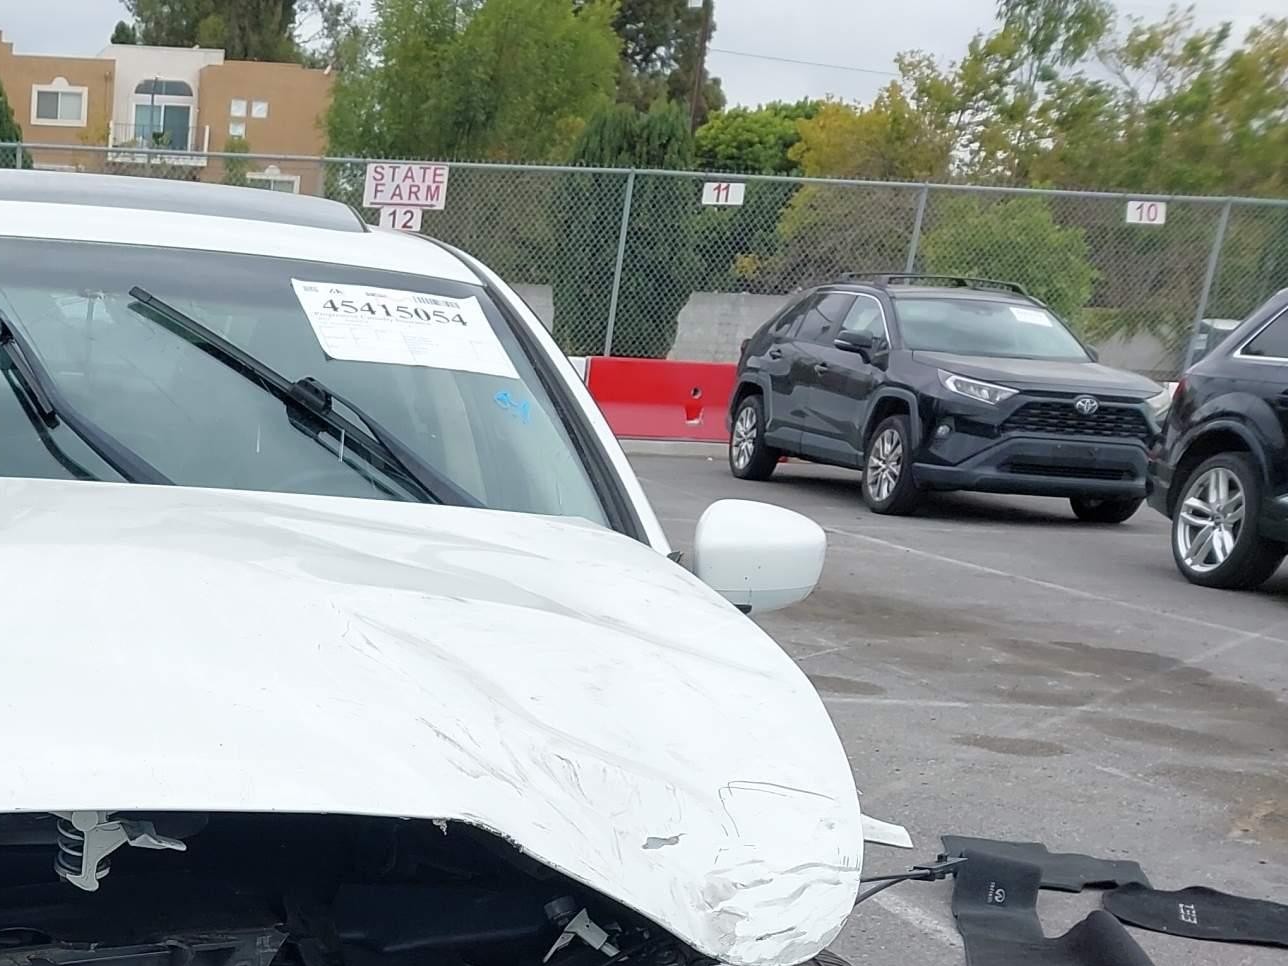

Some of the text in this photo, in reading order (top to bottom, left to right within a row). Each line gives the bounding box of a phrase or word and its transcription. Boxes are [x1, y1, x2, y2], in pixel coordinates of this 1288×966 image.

[372, 165, 445, 184] STATE
[374, 183, 440, 202] FARM
[713, 183, 730, 203] 11
[388, 209, 414, 229] 12
[1136, 203, 1158, 222] 10
[323, 299, 468, 326] 45415054
